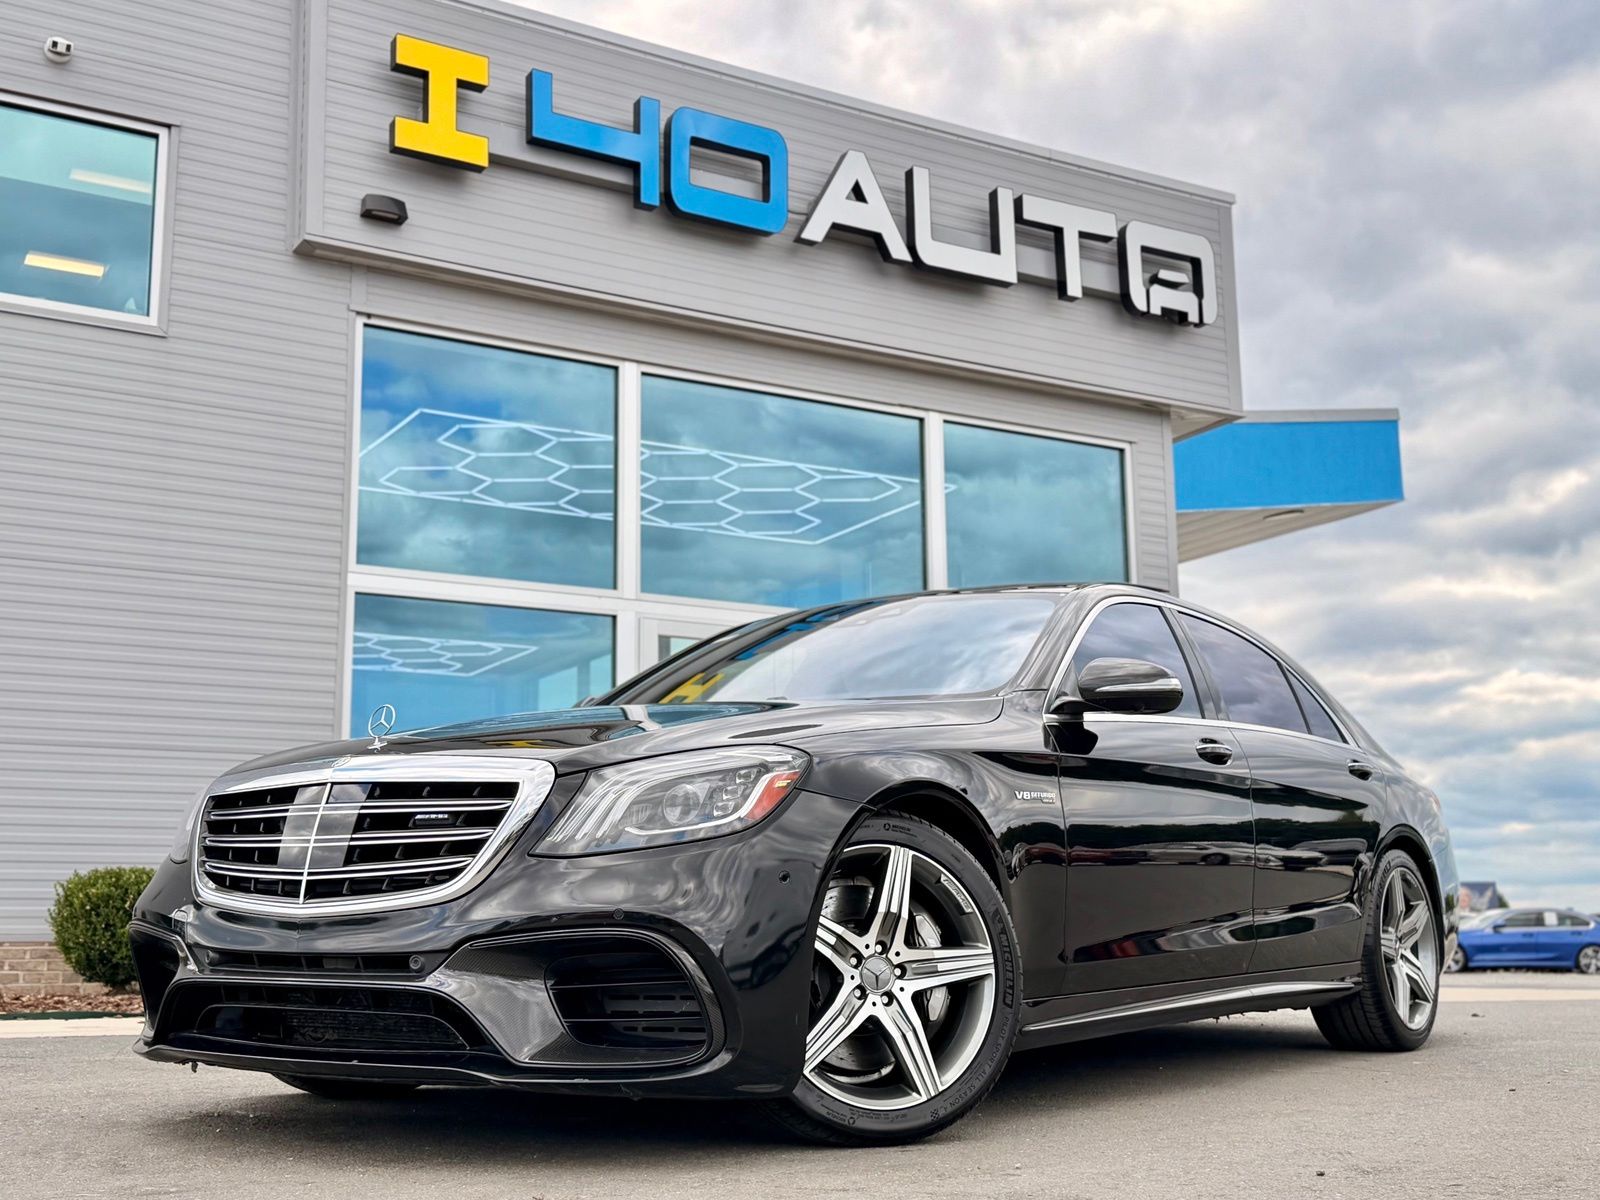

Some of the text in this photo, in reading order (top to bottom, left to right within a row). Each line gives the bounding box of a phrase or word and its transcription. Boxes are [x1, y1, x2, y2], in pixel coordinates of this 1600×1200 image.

[796, 149, 1218, 327] AUTO
[1013, 790, 1031, 800] V8
[999, 932, 1014, 1007] MICHELIN
[987, 1042, 1002, 1069] SPORT
[975, 1068, 988, 1082] ALL
[948, 1084, 977, 1109] SEASON
